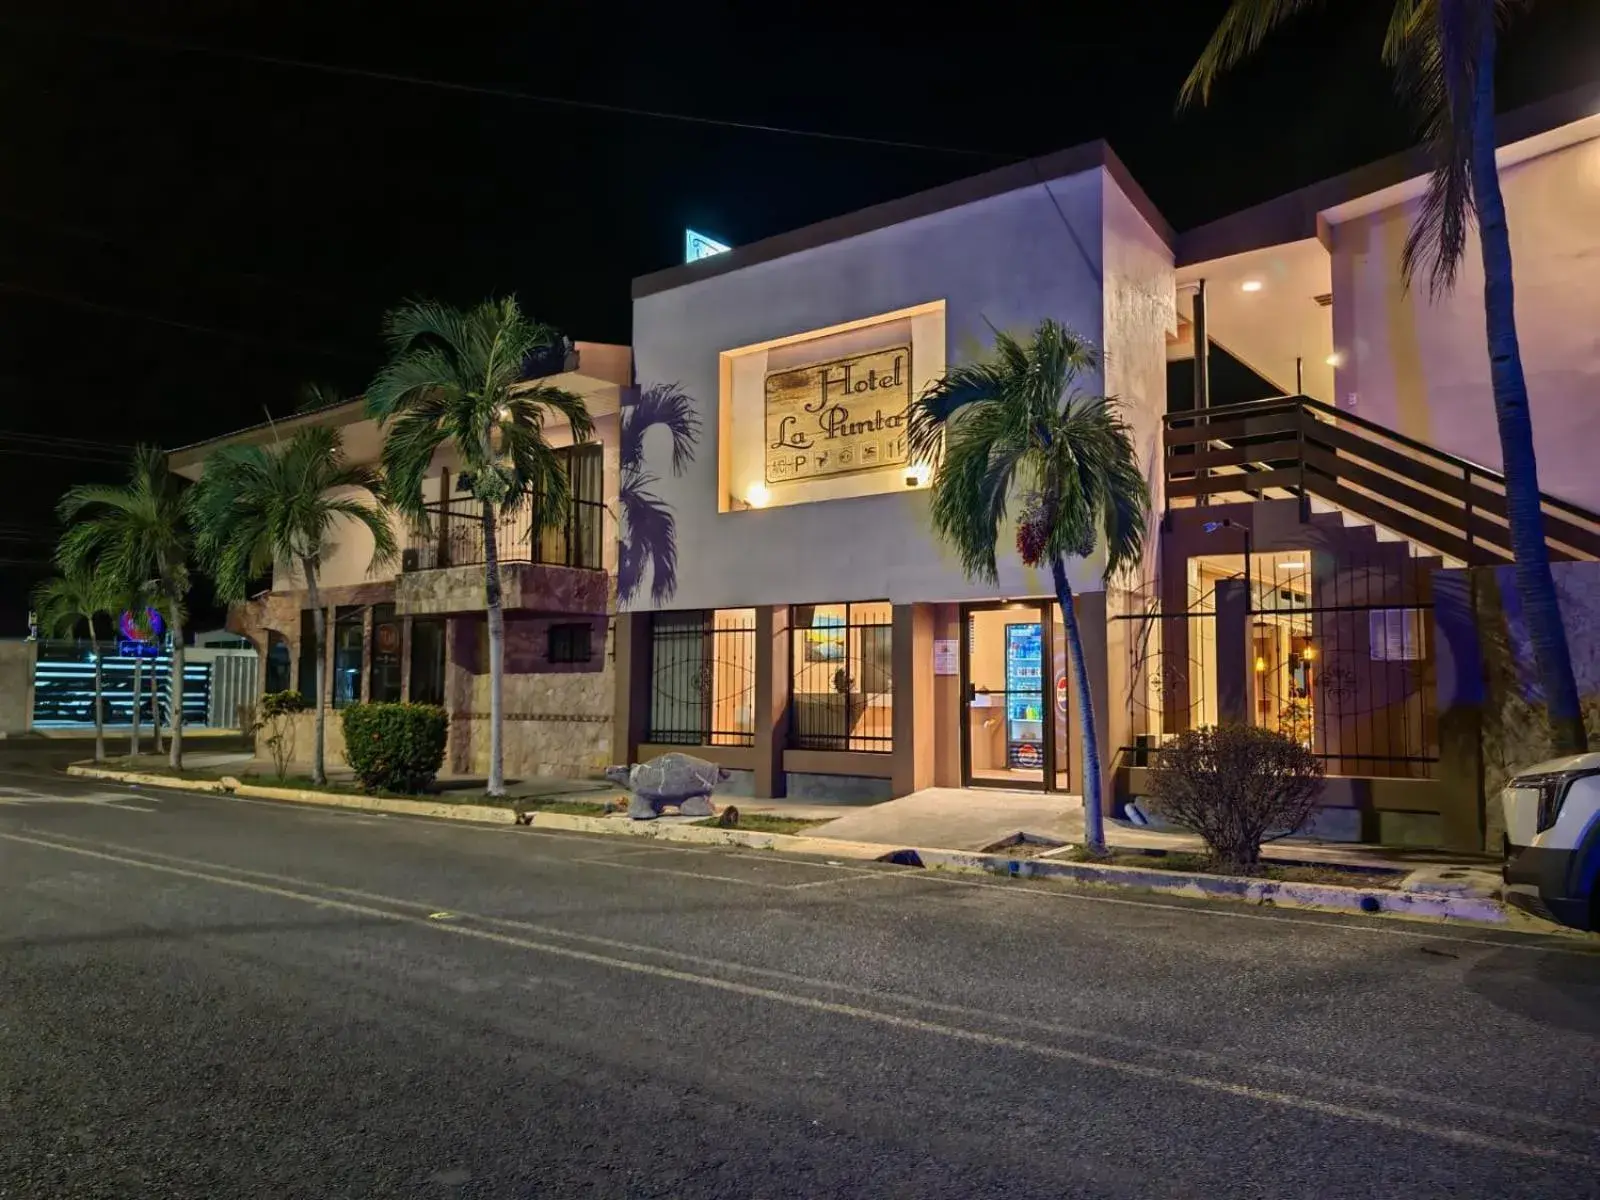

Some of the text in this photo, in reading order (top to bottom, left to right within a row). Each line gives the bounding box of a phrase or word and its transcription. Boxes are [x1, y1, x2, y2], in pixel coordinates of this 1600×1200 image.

[804, 355, 904, 413] Hotel
[771, 403, 904, 450] La Punta
[795, 455, 807, 472] P
